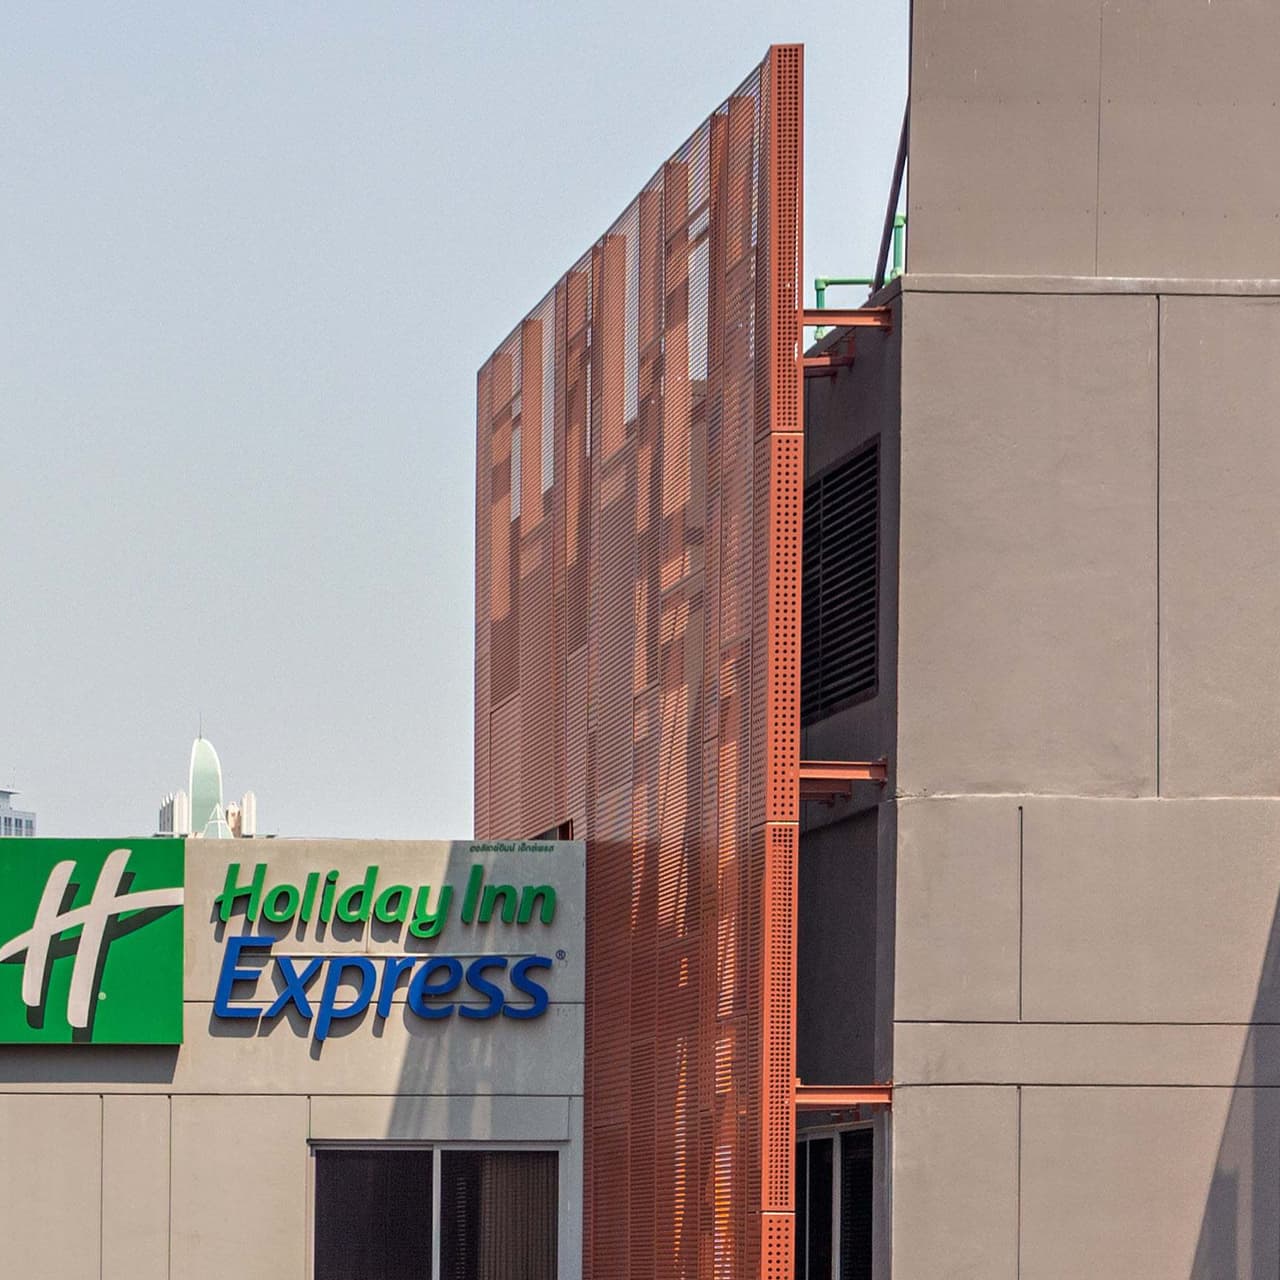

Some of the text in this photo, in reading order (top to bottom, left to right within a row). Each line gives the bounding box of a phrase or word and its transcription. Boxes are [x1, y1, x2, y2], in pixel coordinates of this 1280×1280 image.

[216, 863, 557, 938] Holiday Inn
[213, 935, 553, 1042] Express
